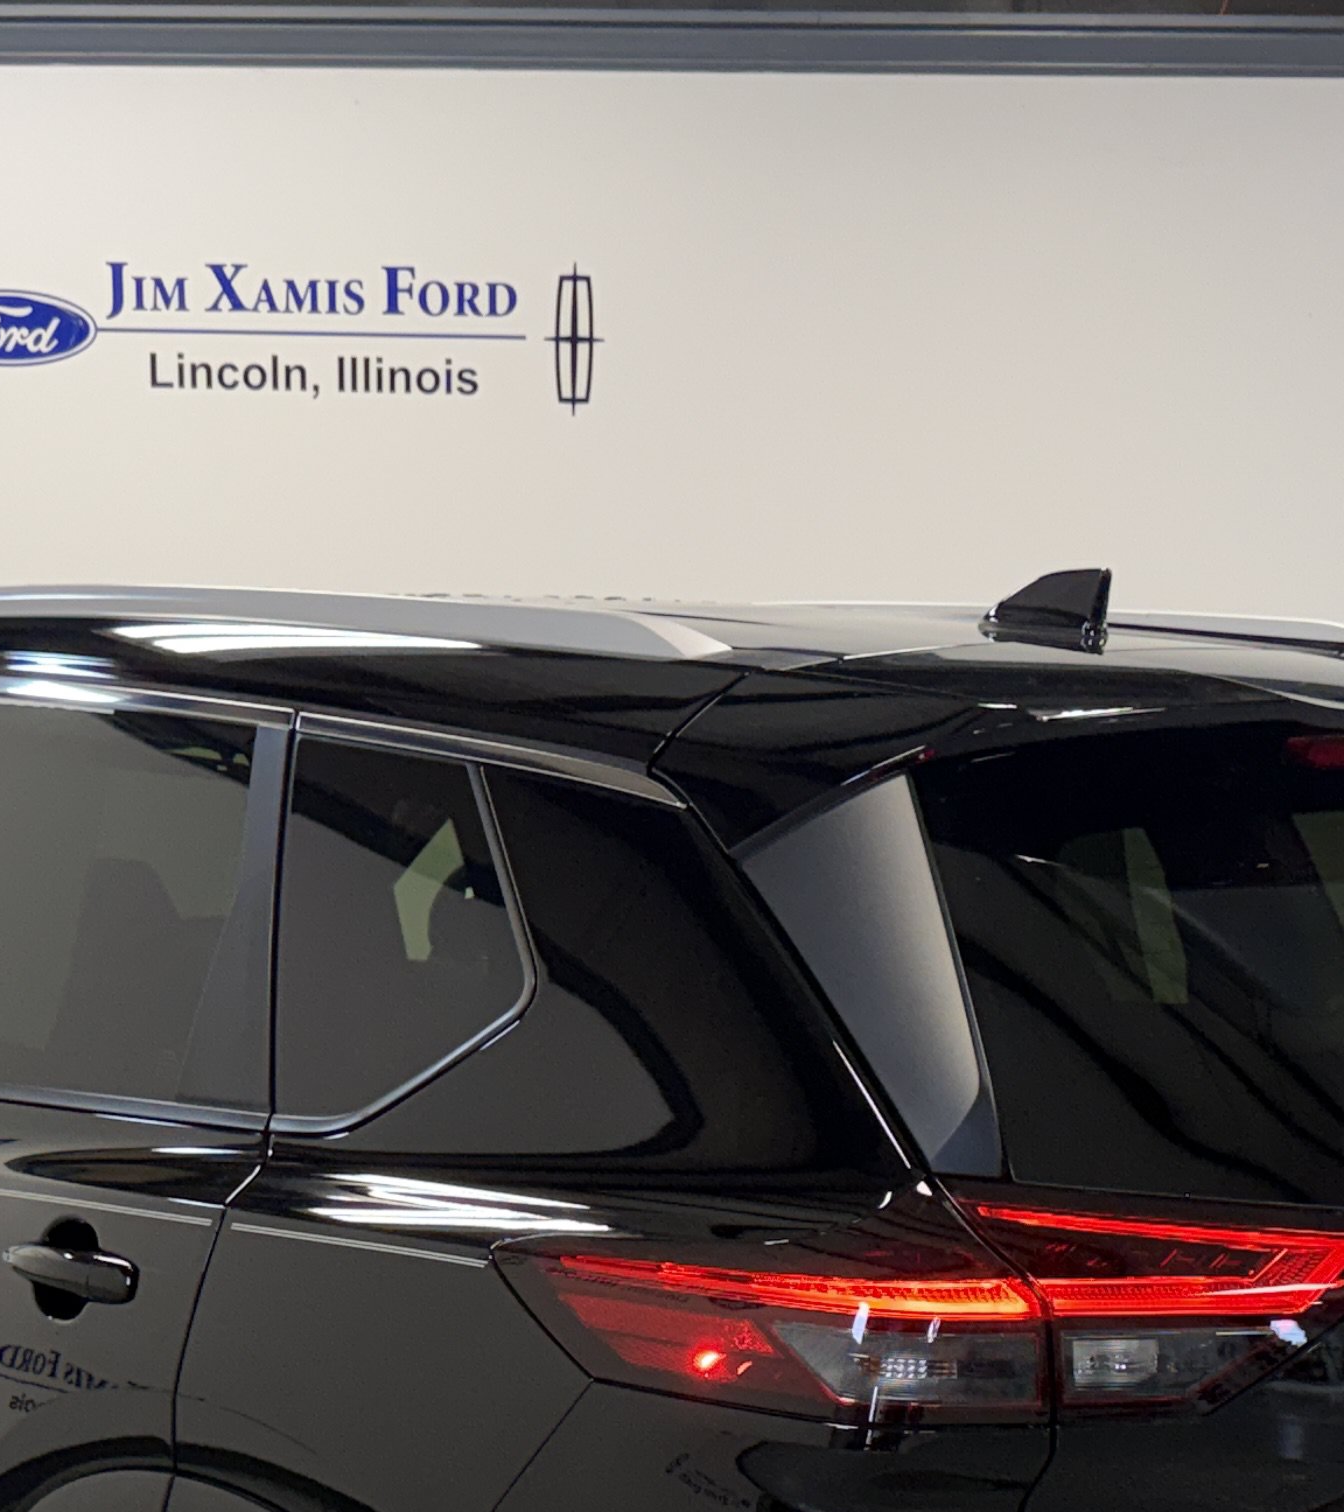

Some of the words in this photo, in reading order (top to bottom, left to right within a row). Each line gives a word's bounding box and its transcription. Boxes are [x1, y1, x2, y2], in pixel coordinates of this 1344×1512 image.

[107, 262, 187, 320] JIM
[207, 264, 365, 315] XAMIS
[383, 266, 518, 318] FORD
[150, 352, 320, 398] Lincoln,
[338, 356, 479, 396] Illinois
